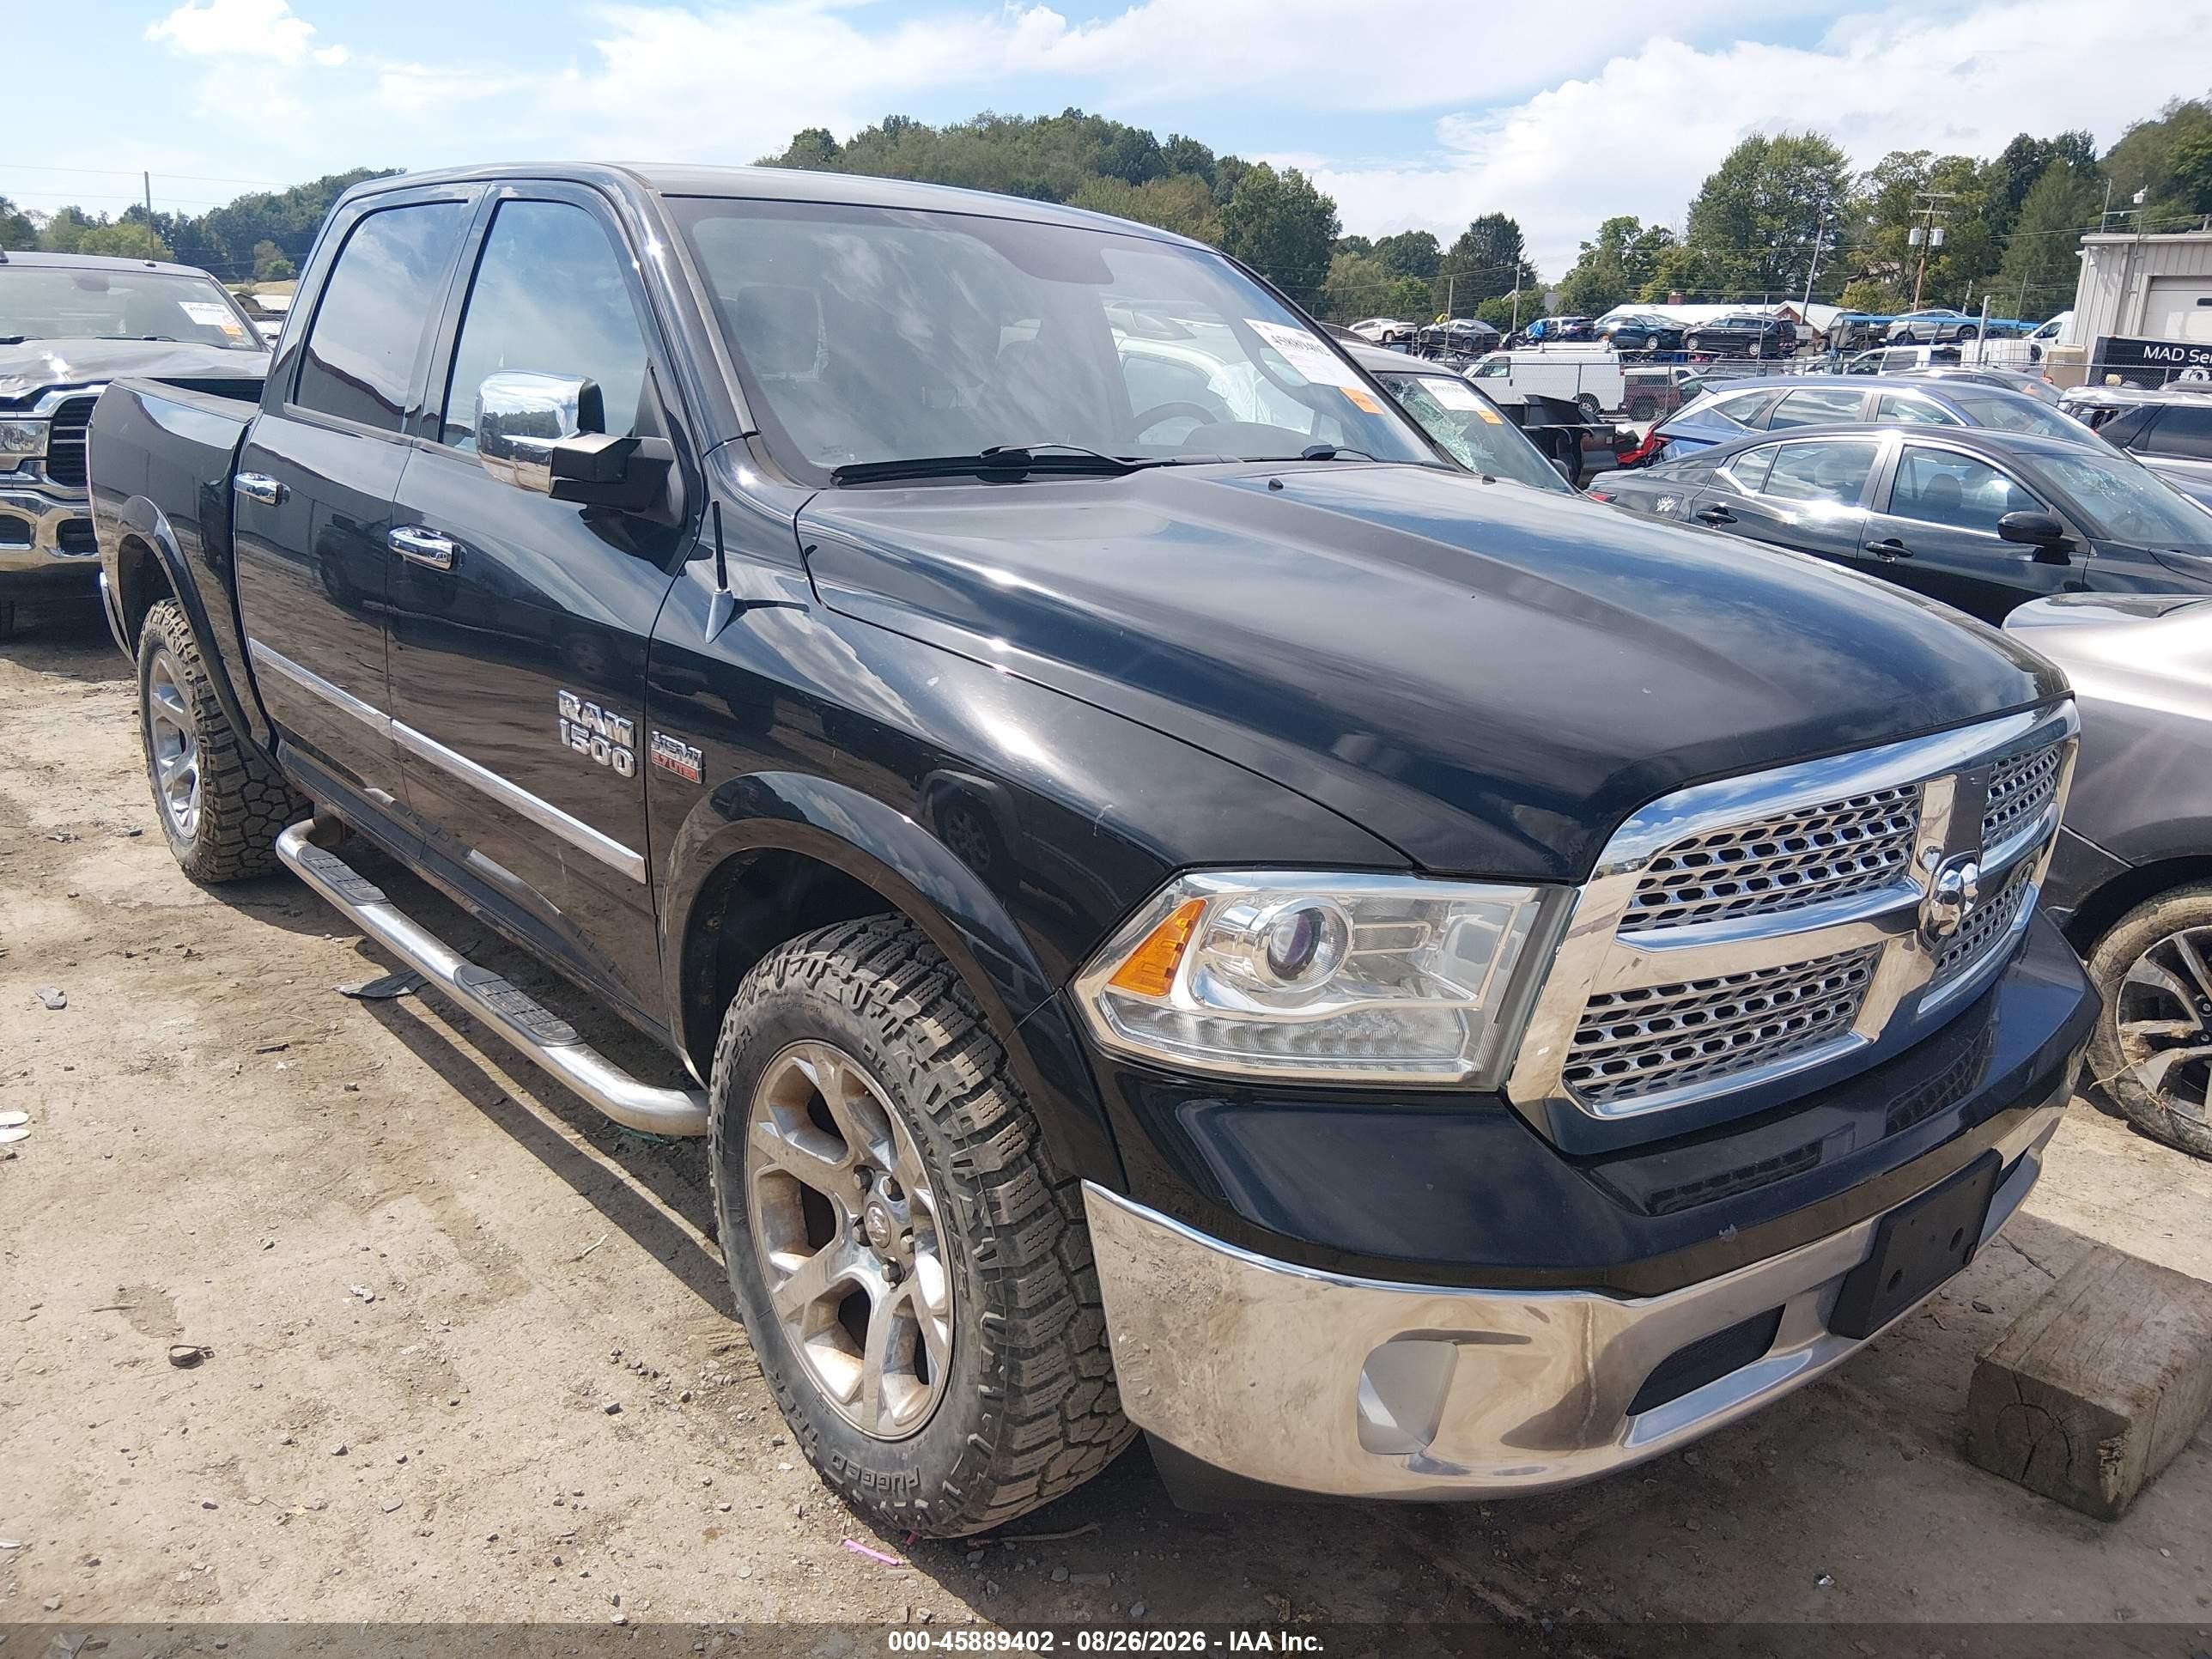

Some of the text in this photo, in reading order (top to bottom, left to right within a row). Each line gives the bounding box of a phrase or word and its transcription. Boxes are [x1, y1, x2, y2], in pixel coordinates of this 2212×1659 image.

[2143, 345, 2185, 362] MAD
[558, 690, 635, 749] RAM
[559, 718, 635, 778] 1500
